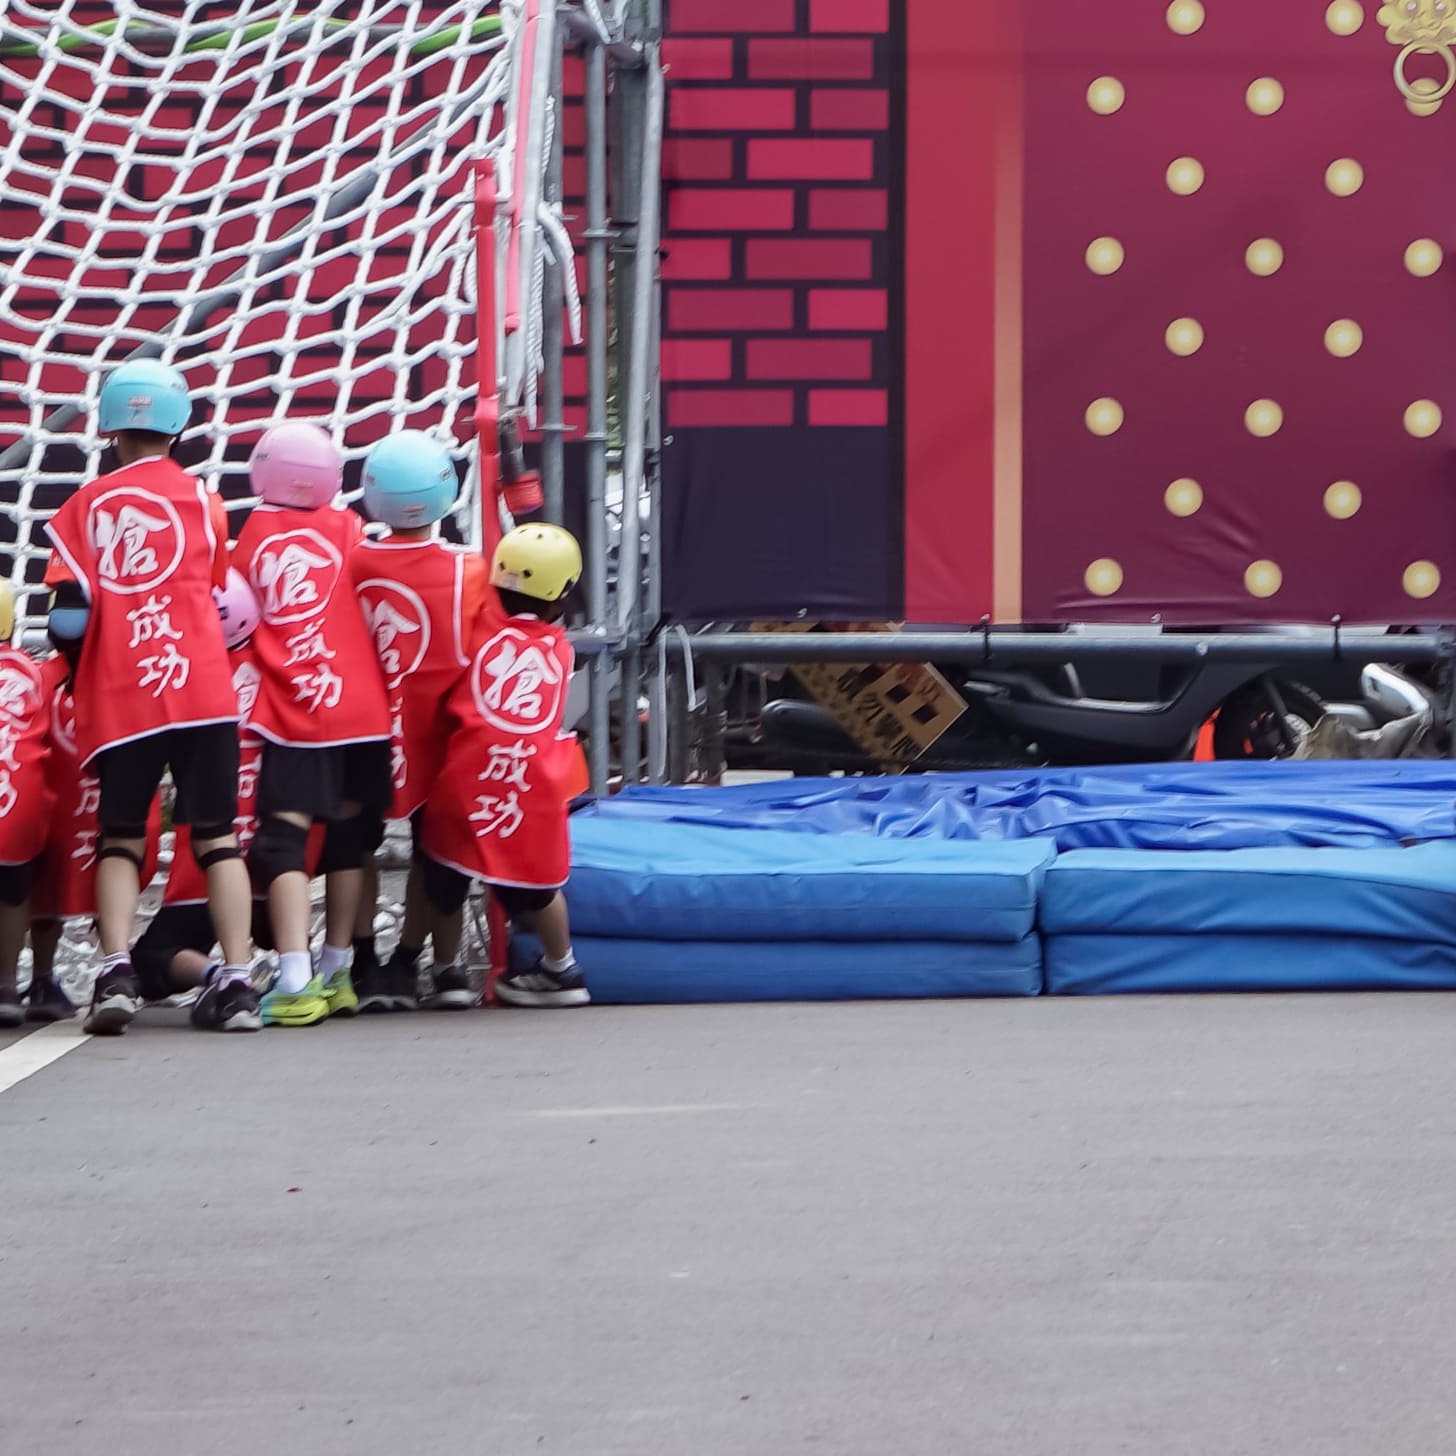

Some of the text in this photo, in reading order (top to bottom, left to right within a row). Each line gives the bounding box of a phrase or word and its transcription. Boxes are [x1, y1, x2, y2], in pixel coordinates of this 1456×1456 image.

[97, 505, 192, 697] 搶成功
[262, 547, 344, 715] 搶成功
[468, 639, 558, 840] 搶成功
